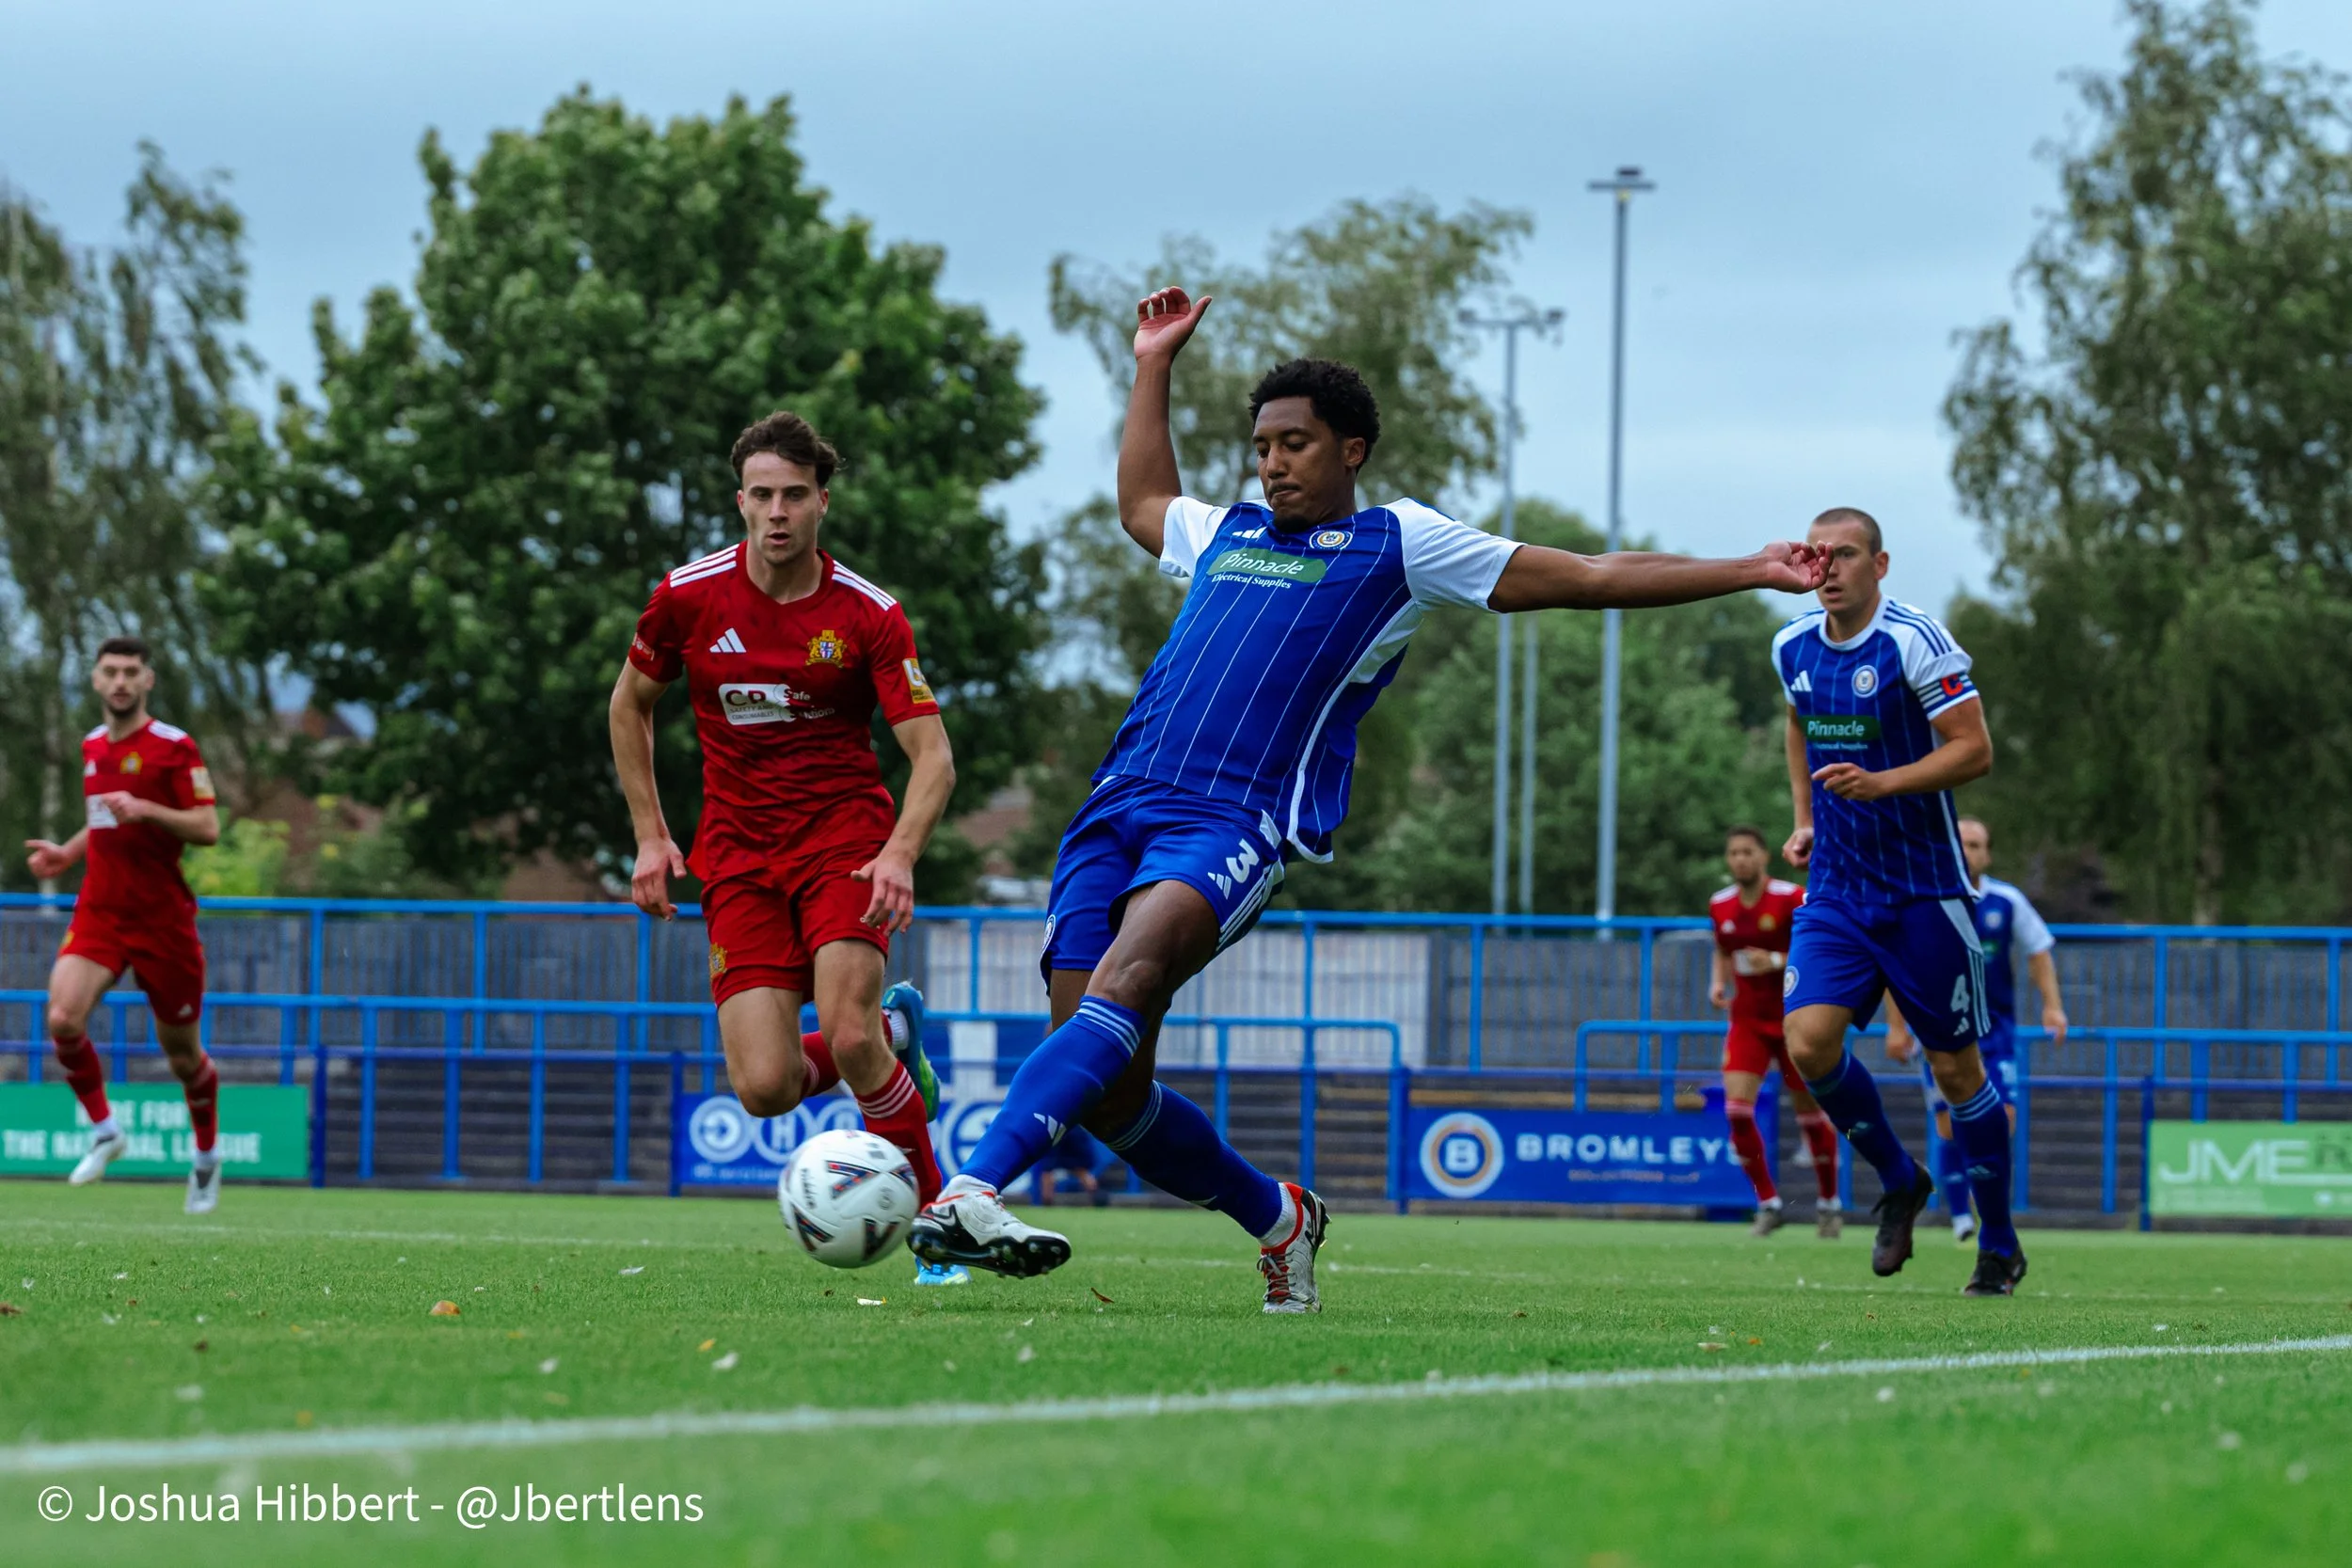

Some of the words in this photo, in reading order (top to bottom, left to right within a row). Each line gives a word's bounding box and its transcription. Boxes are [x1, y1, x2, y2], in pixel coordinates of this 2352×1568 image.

[1220, 552, 1305, 575] Pinnacle
[1211, 573, 1252, 583] Electrical
[1251, 577, 1293, 589] Supplies
[783, 689, 811, 702] Safe
[1940, 674, 1964, 696] C
[1806, 720, 1866, 736] Pinnacle
[1225, 837, 1260, 883] 3
[1950, 974, 1970, 1013] 4
[4, 1130, 46, 1161] THE
